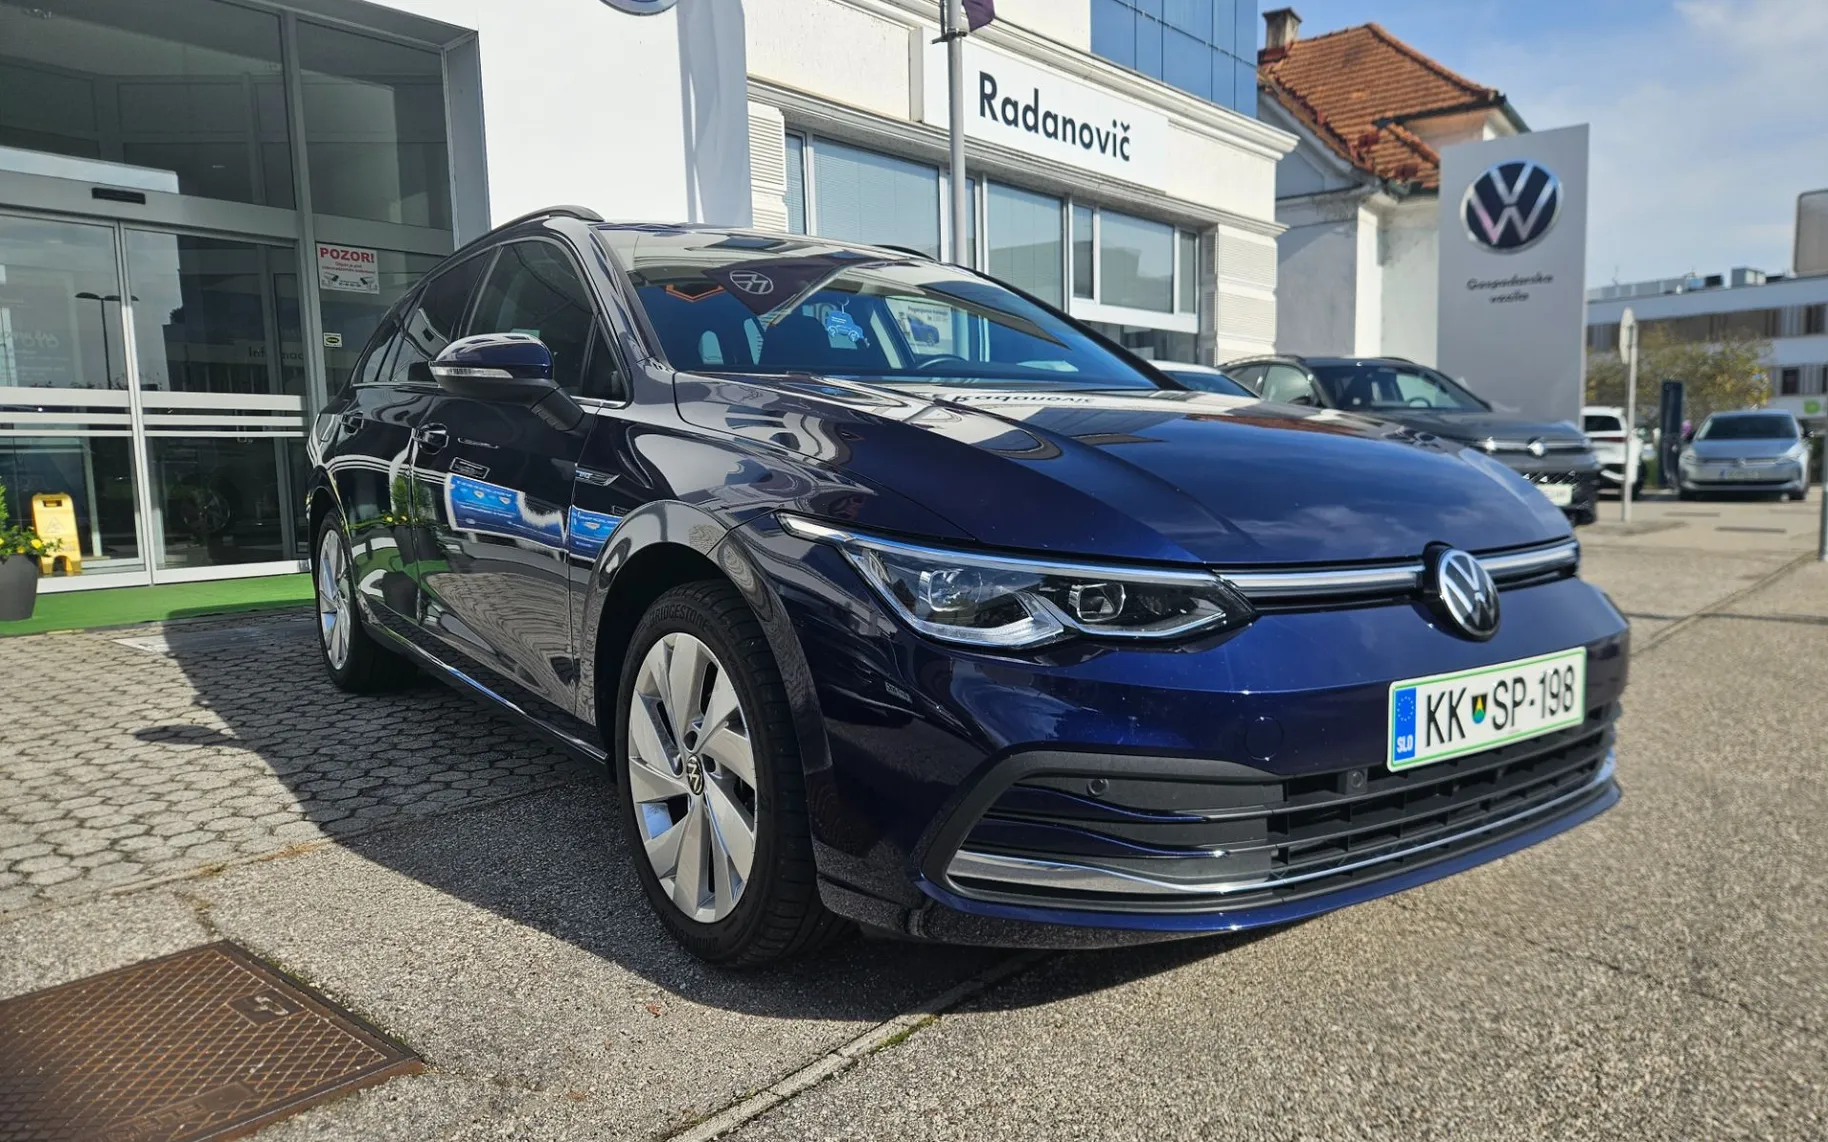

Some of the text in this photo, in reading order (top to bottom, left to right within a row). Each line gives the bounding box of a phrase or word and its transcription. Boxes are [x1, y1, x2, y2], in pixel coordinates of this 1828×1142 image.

[979, 70, 1131, 162] Radanovič
[320, 247, 375, 264] POZOR!
[1425, 664, 1576, 748] KK SP-198
[1396, 734, 1414, 754] SLO
